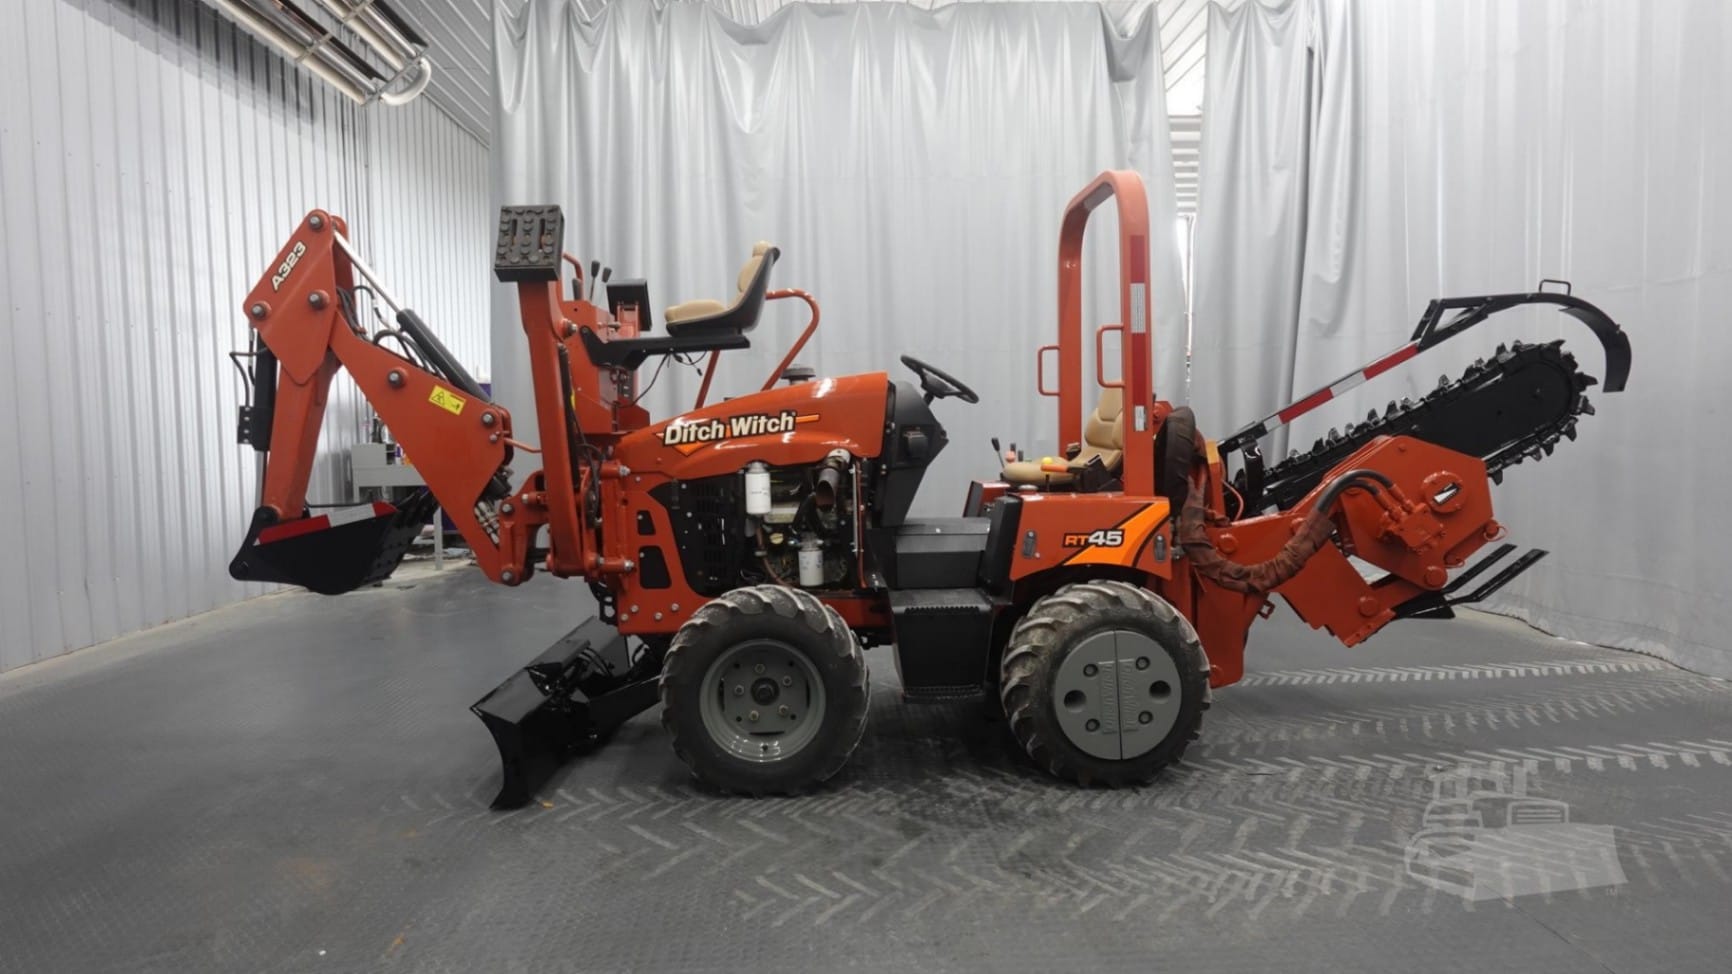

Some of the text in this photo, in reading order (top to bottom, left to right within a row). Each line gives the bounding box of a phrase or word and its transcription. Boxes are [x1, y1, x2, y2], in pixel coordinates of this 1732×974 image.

[271, 240, 307, 291] A323
[664, 411, 795, 446] Ditch Witch
[1064, 530, 1123, 546] RT45
